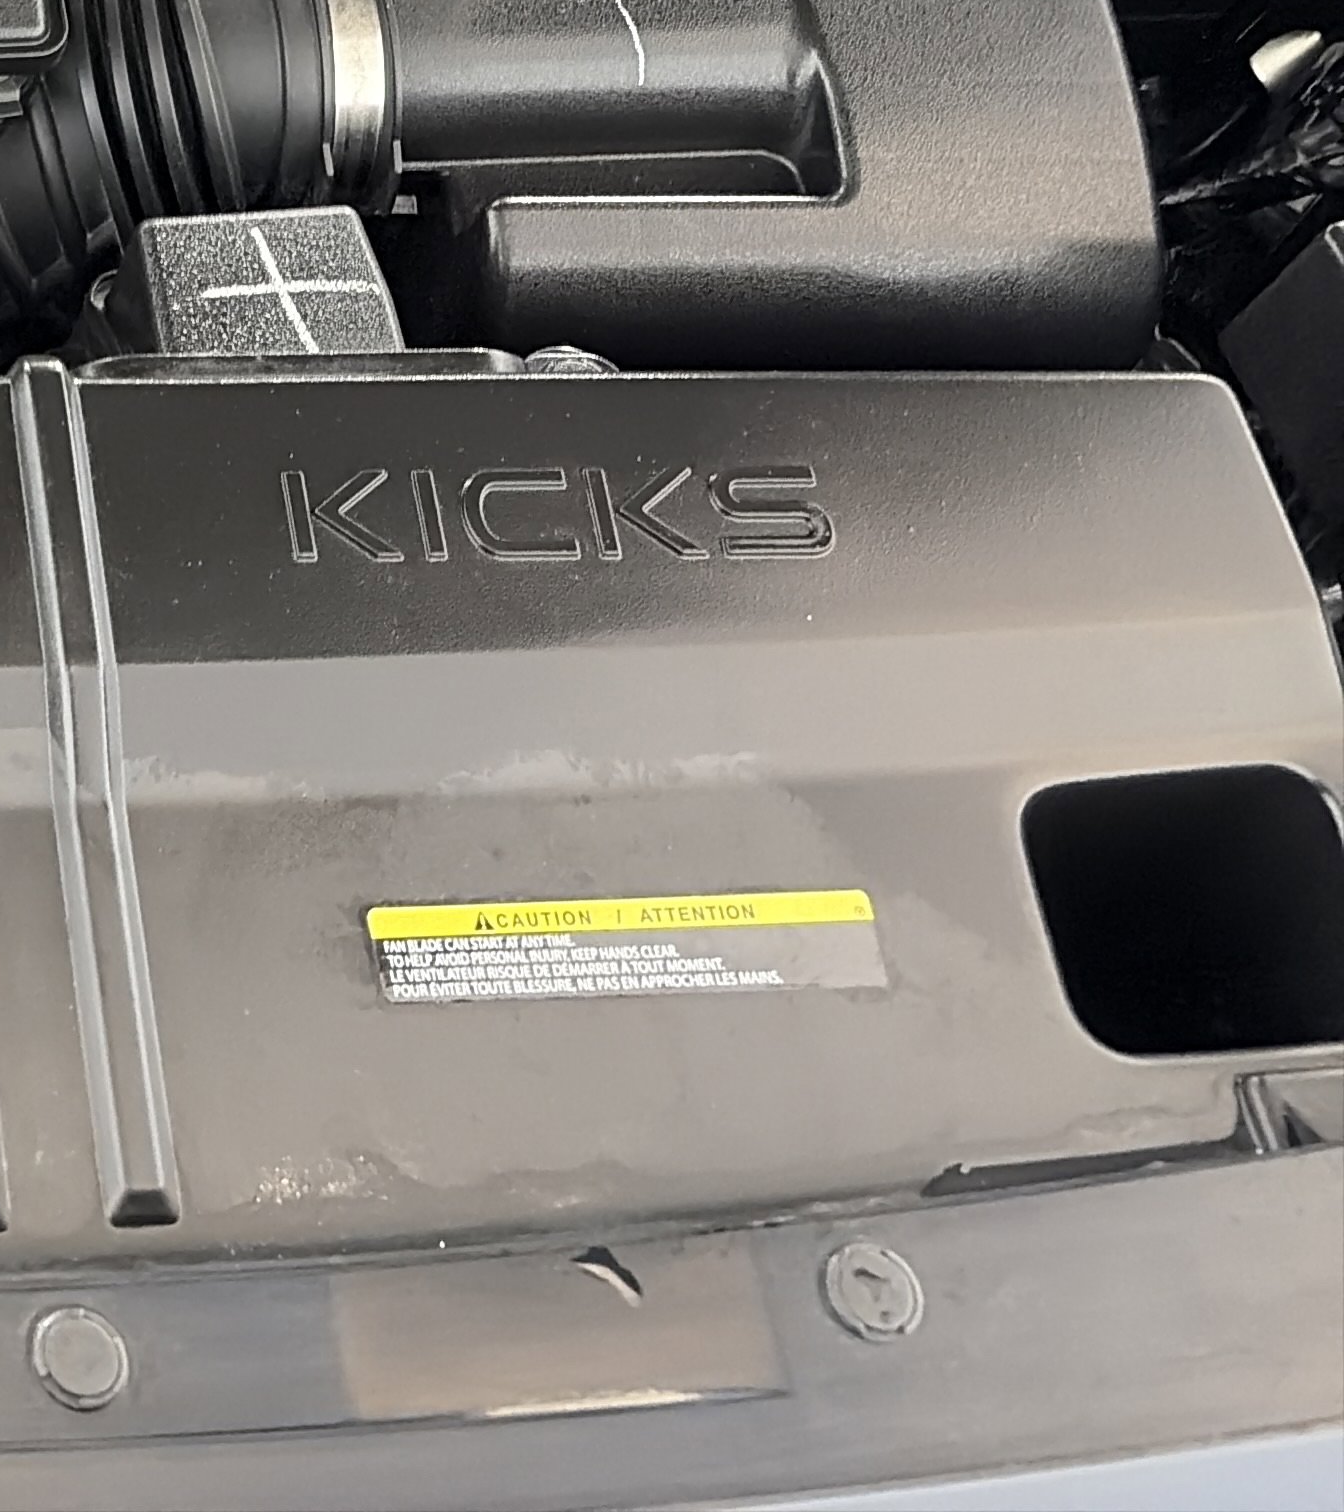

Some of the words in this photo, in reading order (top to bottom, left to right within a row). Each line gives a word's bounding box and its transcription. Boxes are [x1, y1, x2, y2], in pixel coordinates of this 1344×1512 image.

[280, 466, 836, 562] KICKS
[496, 909, 592, 929] CAUTION
[640, 904, 756, 924] ATTENTION
[383, 940, 407, 954] FAN
[407, 938, 444, 953] BLADE
[445, 937, 471, 952] CAN
[471, 936, 505, 950] START
[505, 935, 519, 949] AT
[520, 934, 545, 949] ANY
[387, 954, 404, 968] TO
[406, 953, 433, 968] HELP
[435, 952, 470, 967] AVOID
[470, 950, 529, 966] PERSONAL
[571, 947, 599, 962] KEEP
[599, 945, 640, 960] HANDS
[640, 943, 680, 959] CLEAR.
[390, 968, 405, 983] LE
[406, 965, 487, 982] VENTILATEUR
[488, 964, 532, 980] RISQUE
[532, 963, 551, 977] DE
[632, 958, 665, 974] TOUT
[666, 956, 726, 973] MOMENT.
[392, 982, 429, 999] POUR
[430, 979, 471, 997] ÉVITER
[472, 978, 513, 996] TOUTE
[577, 976, 597, 991] NE
[597, 975, 620, 990] PAS
[621, 974, 640, 989] EN
[640, 971, 714, 989] APPROCHER
[715, 970, 739, 986] LES
